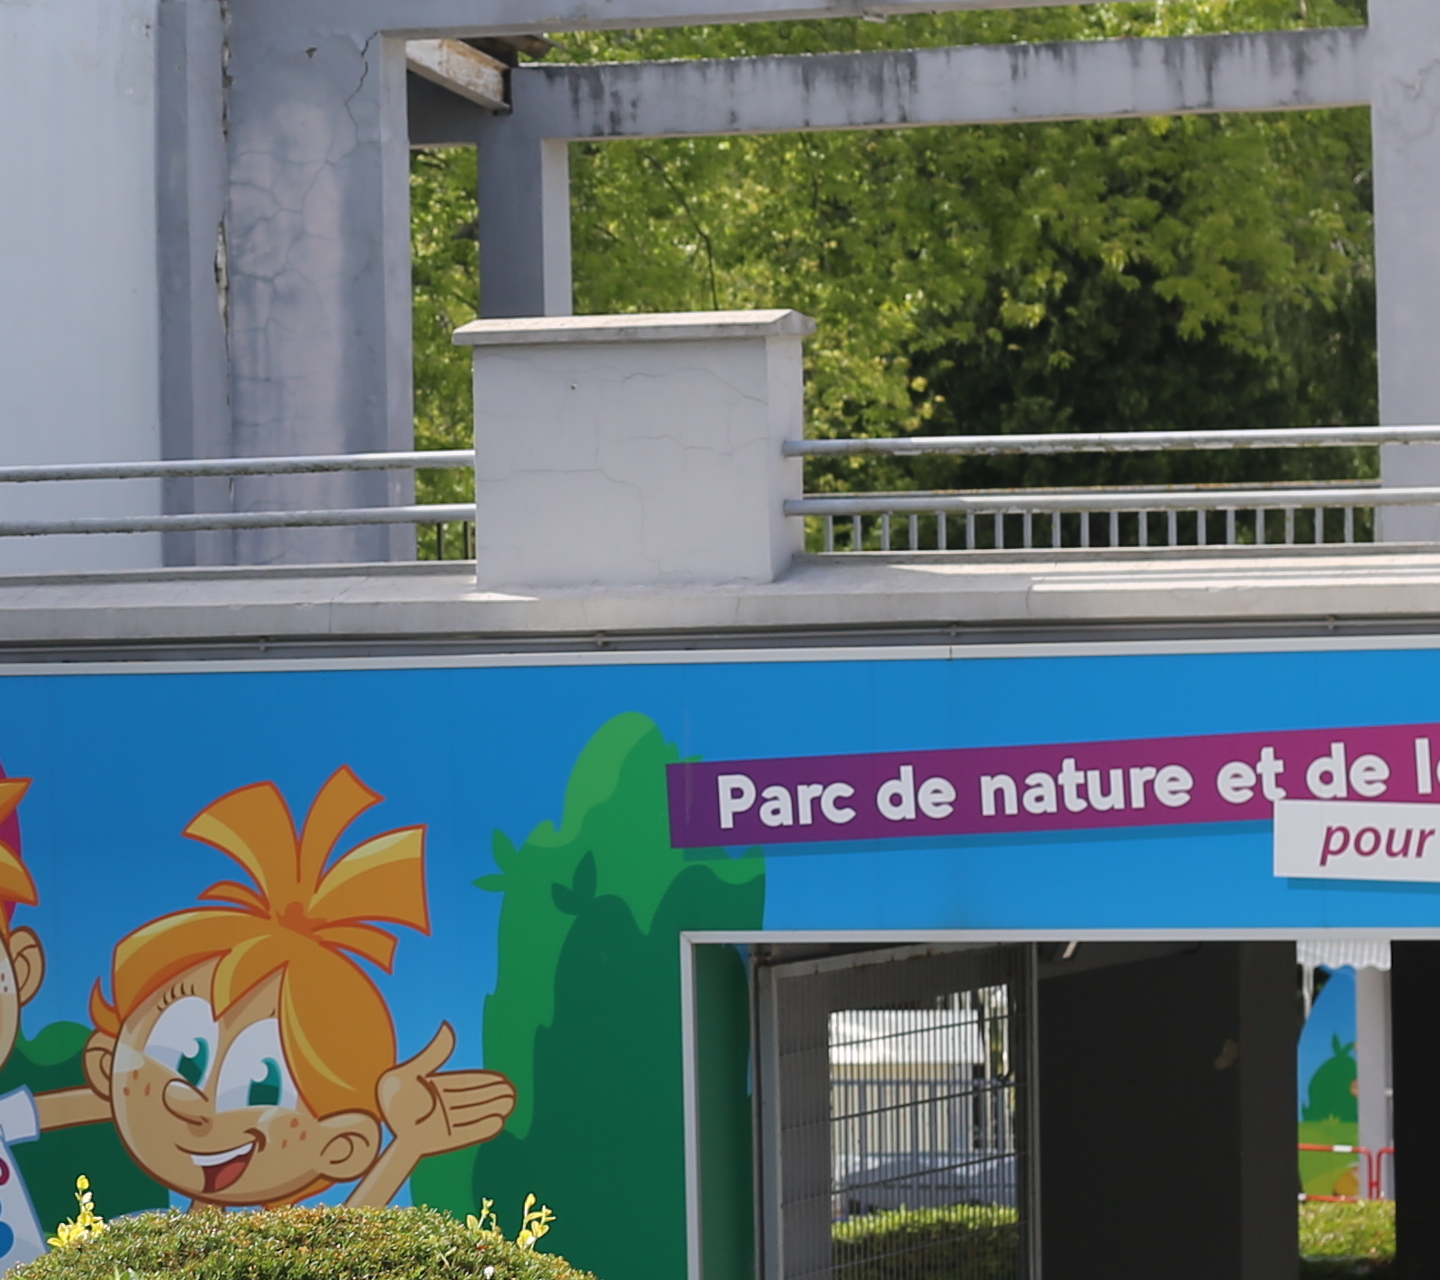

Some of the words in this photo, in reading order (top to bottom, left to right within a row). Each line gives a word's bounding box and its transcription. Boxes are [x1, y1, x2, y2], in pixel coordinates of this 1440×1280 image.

[717, 772, 857, 829] Parc
[876, 765, 957, 821] de
[979, 757, 1195, 817] nature
[1216, 746, 1286, 804] et
[1306, 741, 1390, 799] de
[1319, 823, 1435, 867] pour
